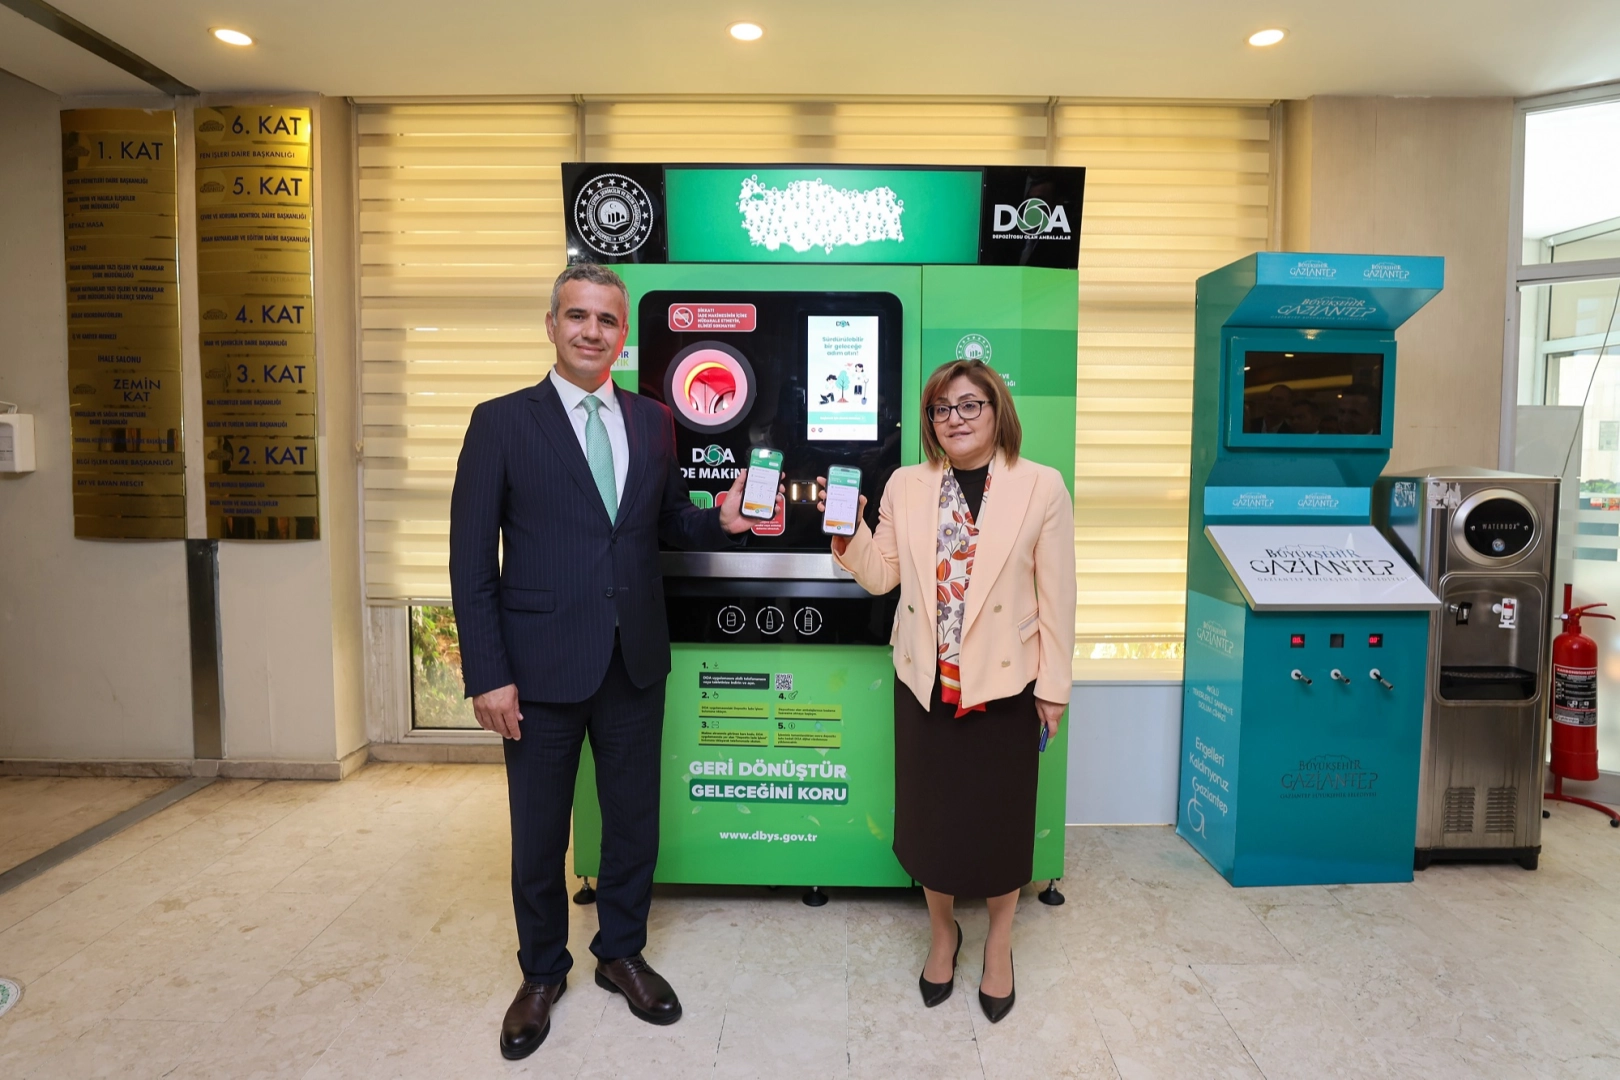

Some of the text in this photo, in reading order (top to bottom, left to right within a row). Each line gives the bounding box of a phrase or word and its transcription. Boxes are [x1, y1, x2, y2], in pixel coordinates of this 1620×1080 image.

[232, 115, 250, 134] 6.
[259, 115, 301, 135] KAT
[98, 141, 112, 160] 1.
[121, 141, 163, 160] KAT
[120, 176, 148, 185] BAŞKANLIĞI
[232, 177, 251, 195] 5.
[260, 177, 302, 196] KAT
[280, 235, 310, 243] BAŞKANLIĞI
[1302, 298, 1366, 307] BÜYÜKŞEHİR
[235, 304, 253, 323] 4.
[262, 304, 304, 324] KAT
[237, 364, 255, 383] 3.
[264, 364, 306, 383] KAT
[114, 377, 160, 390] ZEMİN
[124, 392, 150, 402] KAT
[131, 458, 173, 466] BAŞKANLIĞI
[238, 446, 256, 465] 2.
[265, 446, 307, 465] KAT
[692, 445, 735, 466] DOA
[1265, 549, 1361, 559] BÜYÜKŞEHİR
[1195, 736, 1224, 767] Engelleri
[689, 758, 847, 781] GERİ DÖNÜŞTÜR
[1189, 752, 1229, 793] Kaldırıyoruz
[1299, 760, 1362, 773] BÜYÜKŞEHİR
[691, 783, 847, 800] GELECEĞİNİ KORU
[1192, 776, 1228, 817] Gaziantep
[719, 831, 818, 843] www.dbys.gov.tr
